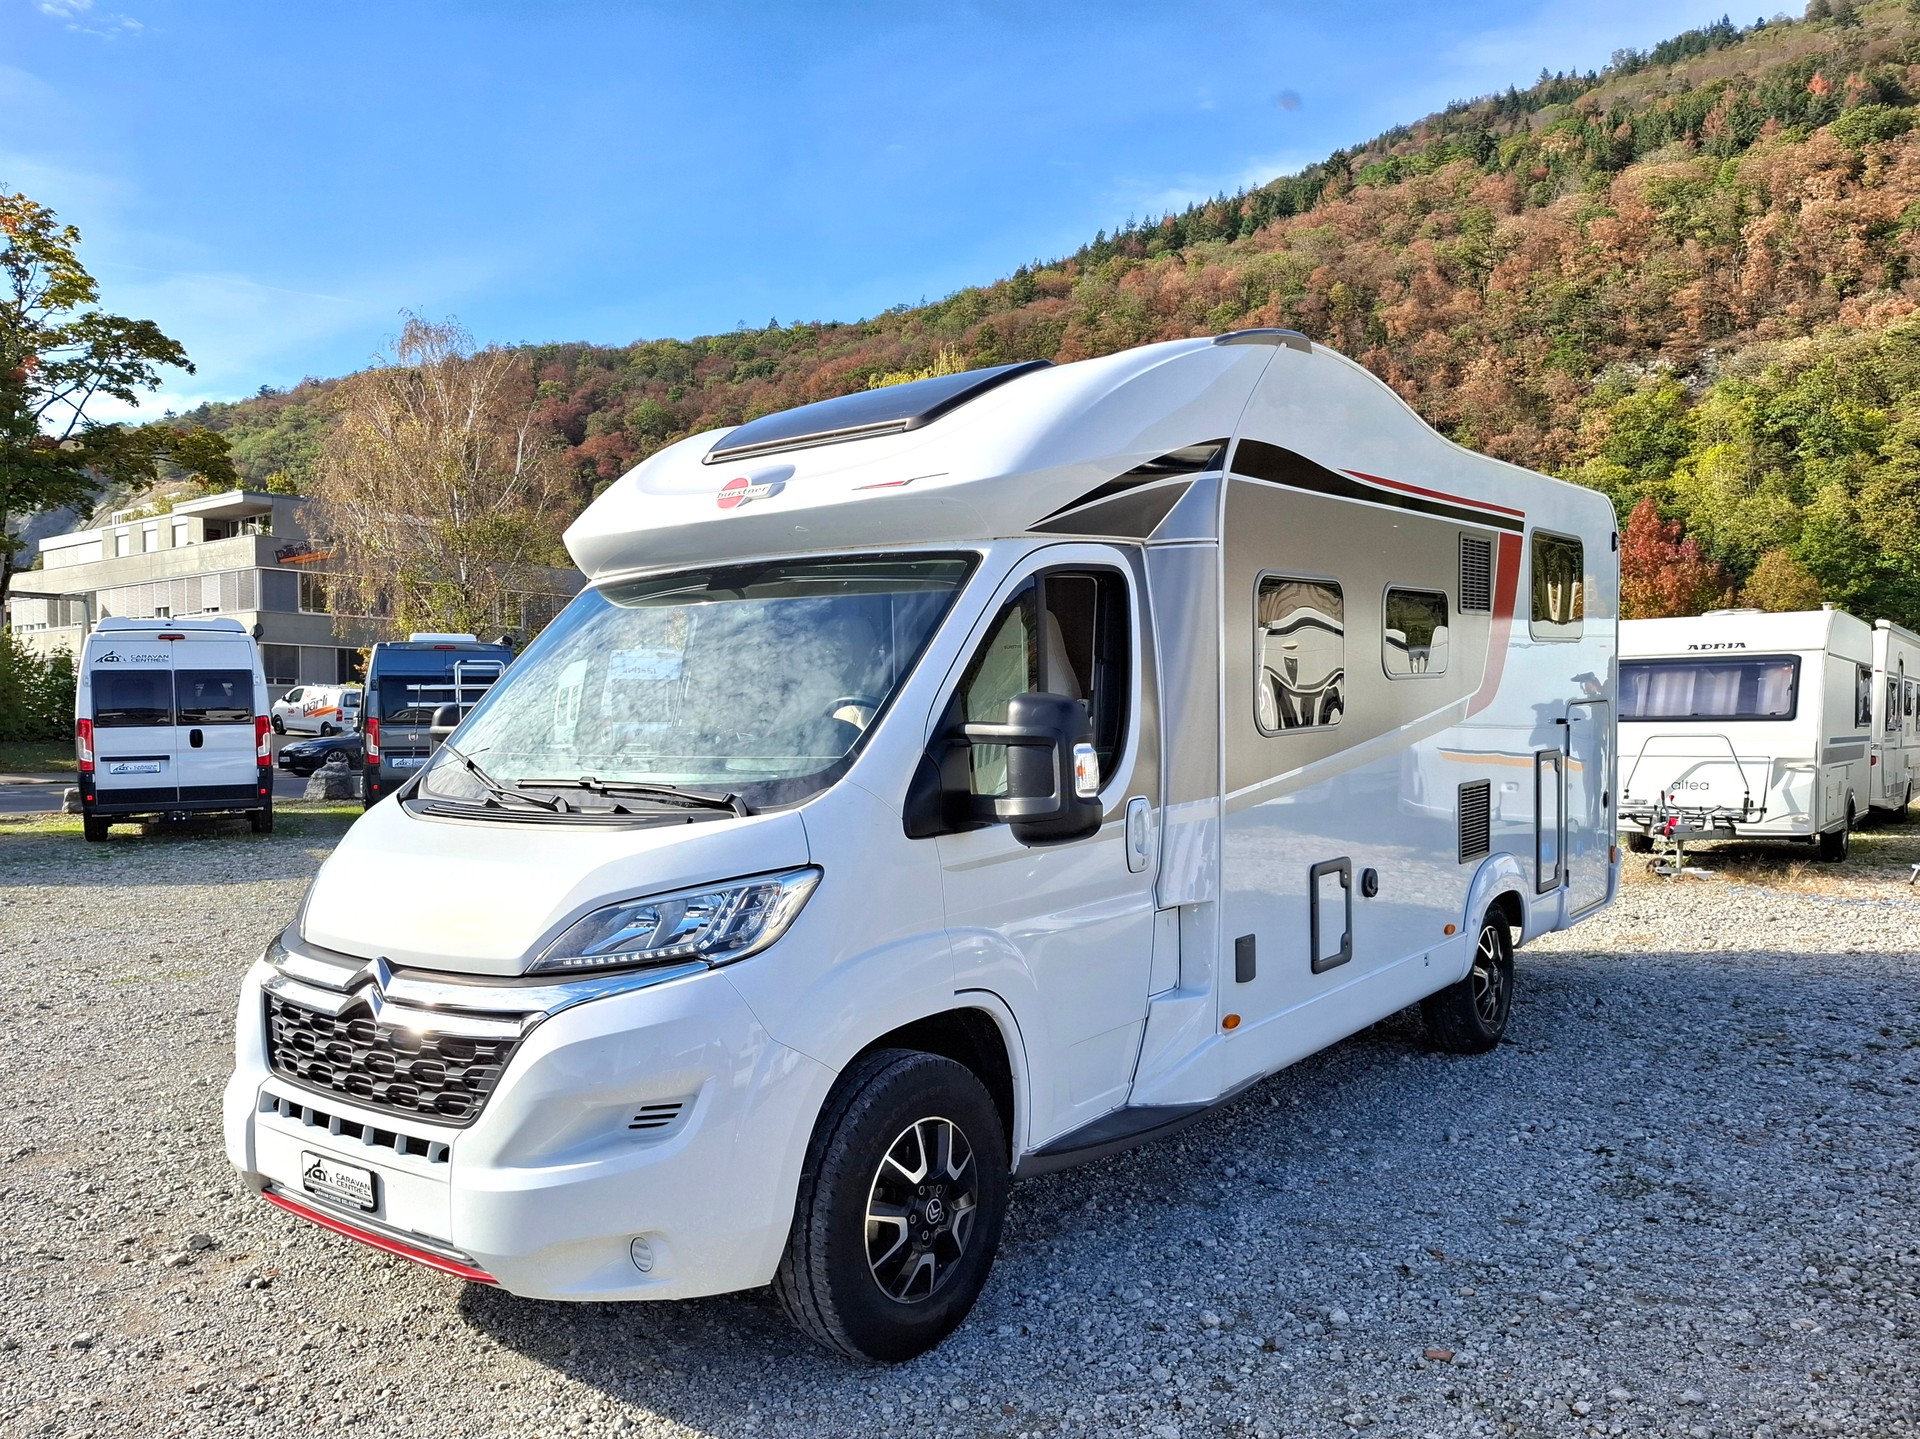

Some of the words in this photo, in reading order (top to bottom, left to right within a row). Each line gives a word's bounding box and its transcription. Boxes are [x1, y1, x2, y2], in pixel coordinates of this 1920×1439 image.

[1687, 642, 1746, 651] ADRIA
[1671, 779, 1709, 790] altea
[335, 1172, 371, 1191] CARAVAN
[336, 1180, 364, 1196] CENTRE
